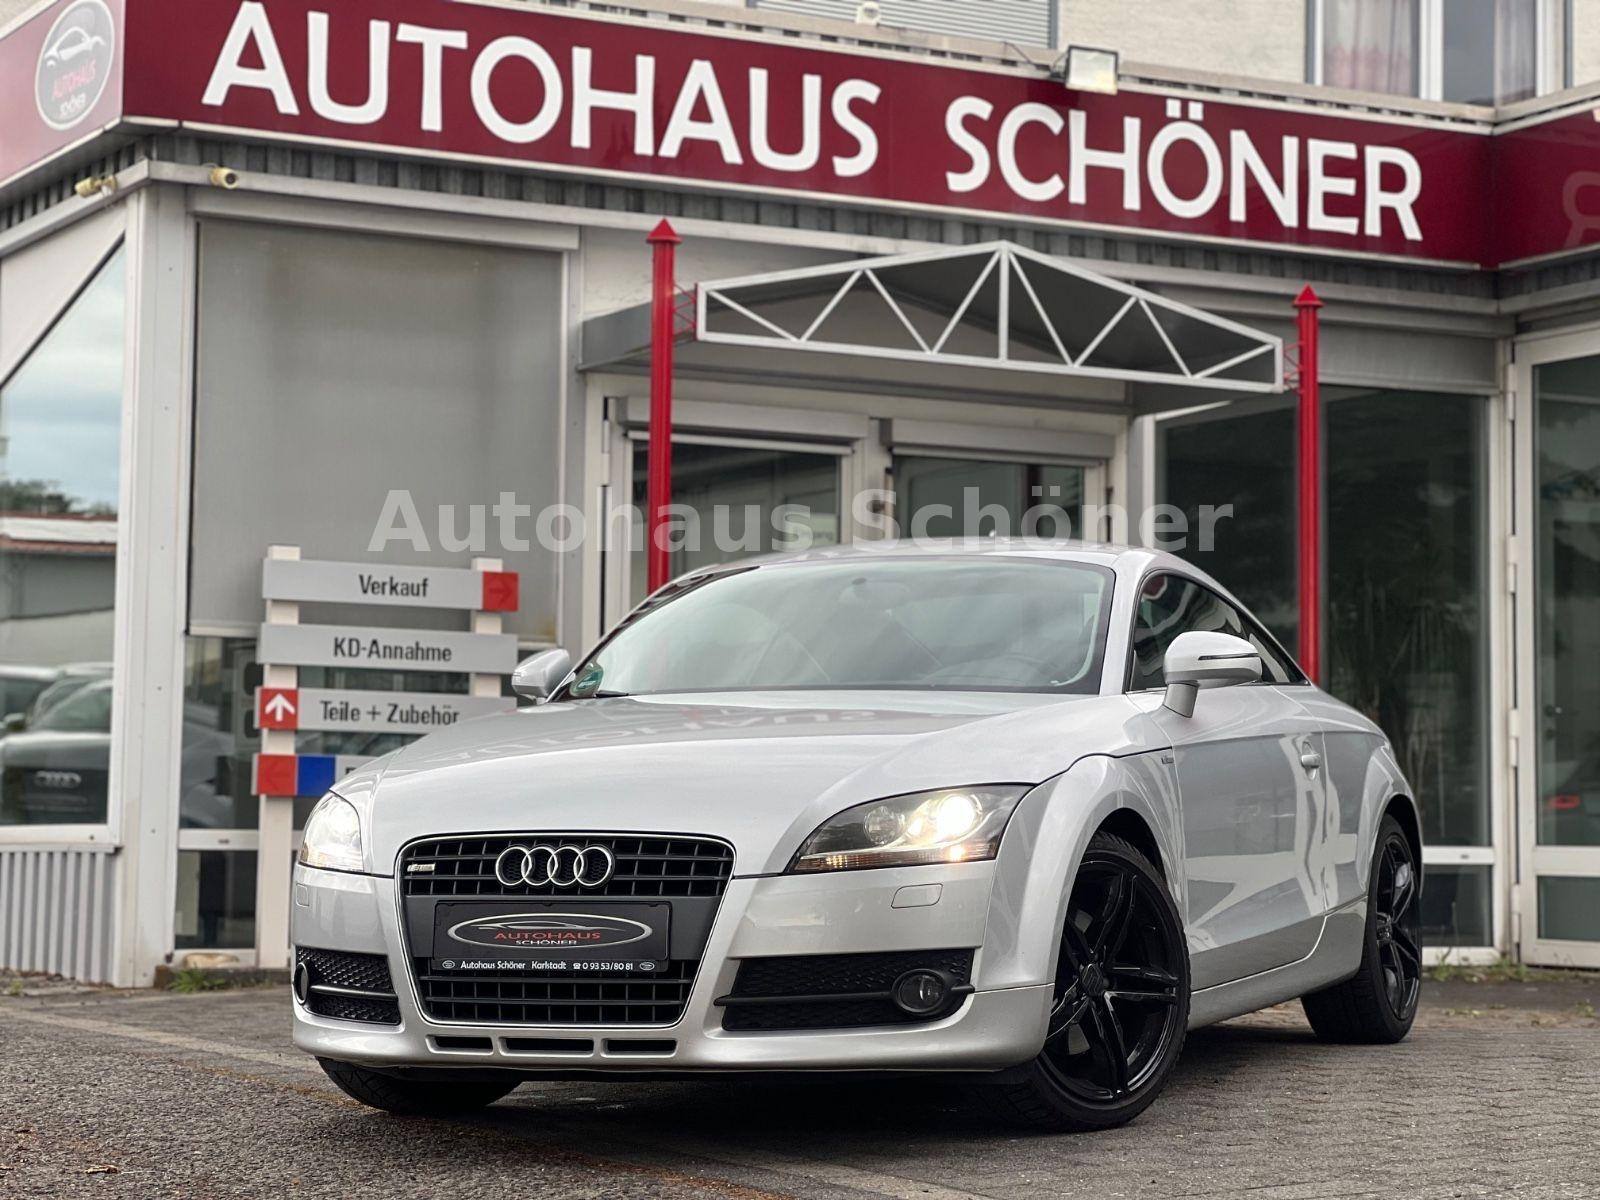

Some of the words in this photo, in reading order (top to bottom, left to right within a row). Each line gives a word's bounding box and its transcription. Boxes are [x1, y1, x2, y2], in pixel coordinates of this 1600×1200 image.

[202, 1, 881, 178] AUTOHAUS
[945, 98, 1423, 242] SCHÖNER
[359, 574, 429, 598] Verkauf
[333, 637, 452, 662] KD-Annahme
[320, 701, 361, 722] Teile
[367, 705, 382, 721] +
[387, 703, 460, 724] Zubehör
[494, 931, 601, 940] AUTOHAUS
[460, 961, 496, 970] Autohaus
[497, 960, 526, 970] Schöner
[531, 961, 567, 970] Karlstadt
